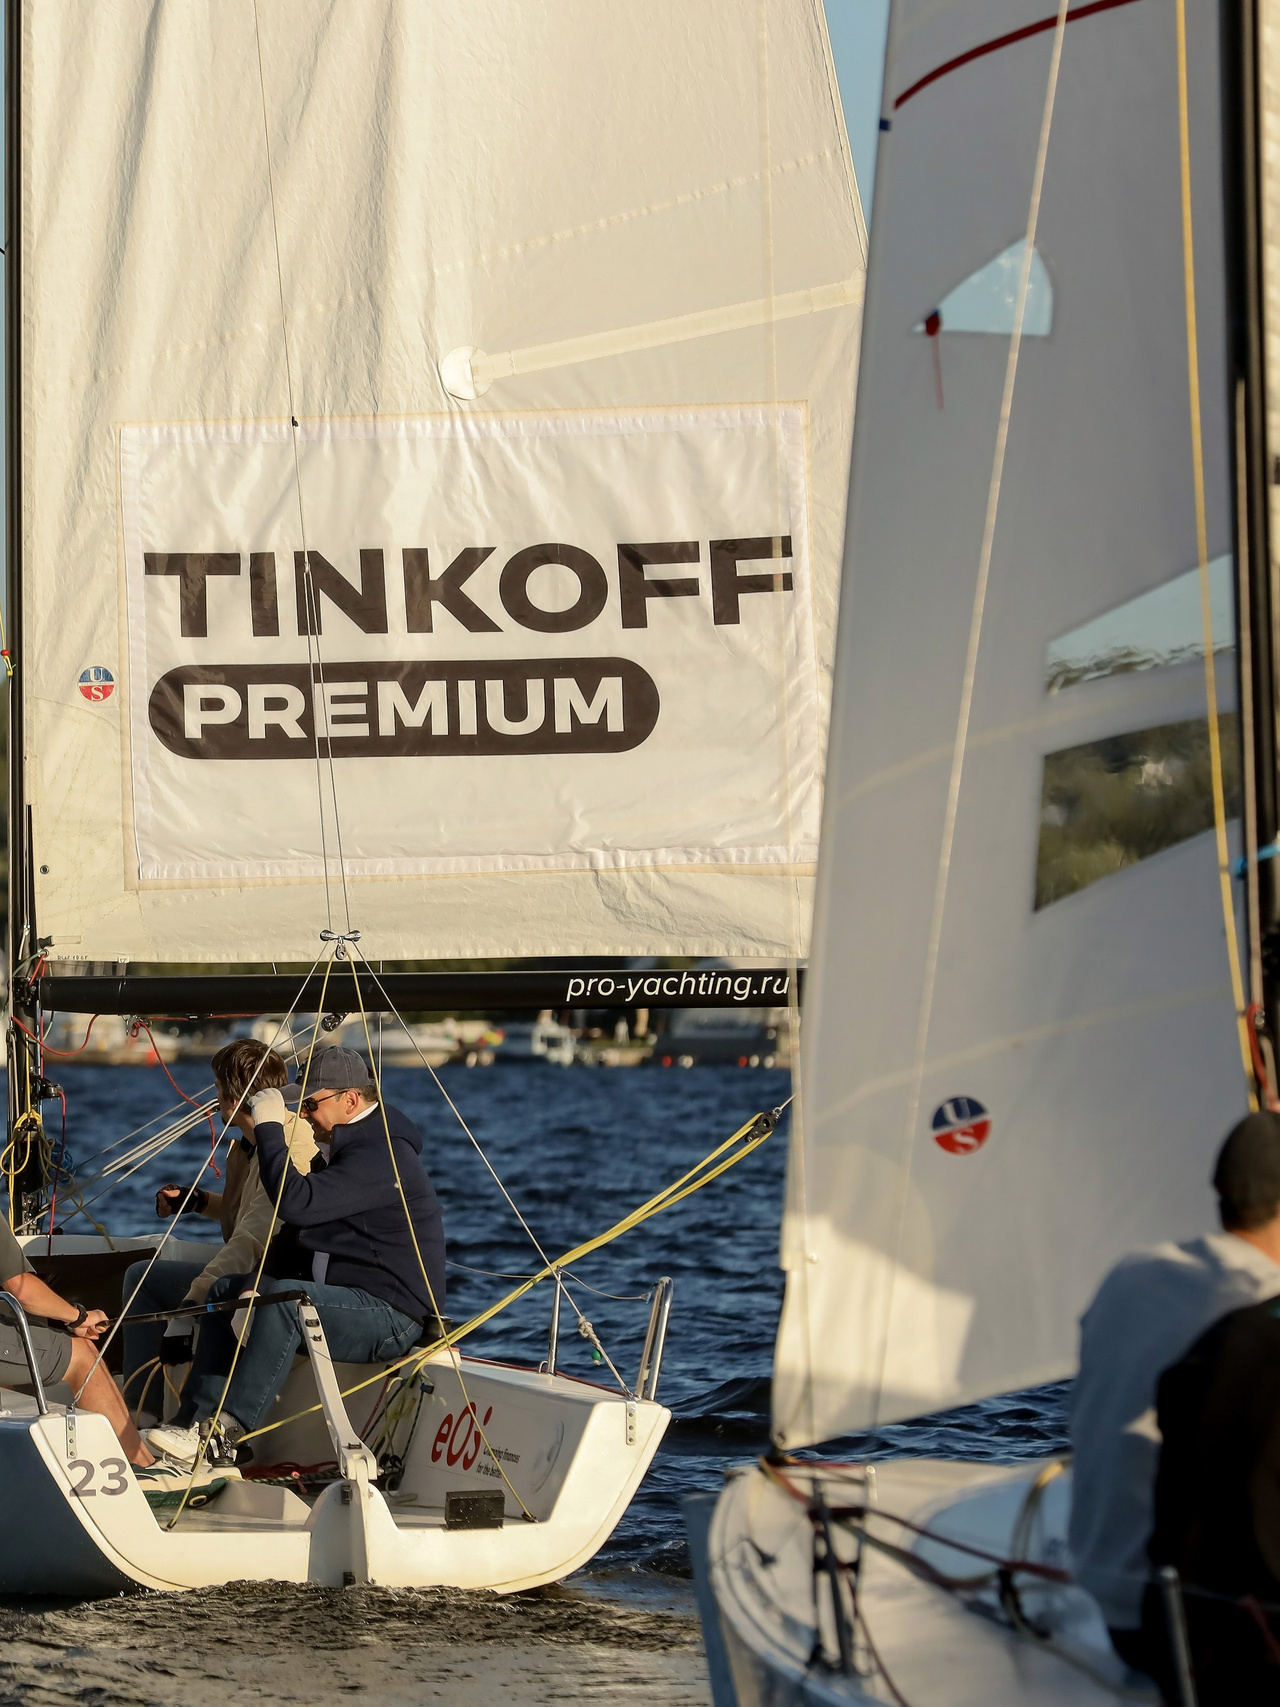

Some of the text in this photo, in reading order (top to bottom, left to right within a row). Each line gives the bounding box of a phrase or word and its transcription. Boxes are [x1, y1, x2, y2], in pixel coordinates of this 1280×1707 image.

[144, 535, 793, 637] TINKOFF
[183, 677, 624, 739] PREMIUM
[566, 972, 791, 1002] pro-yachting.ru
[67, 1457, 129, 1498] 23
